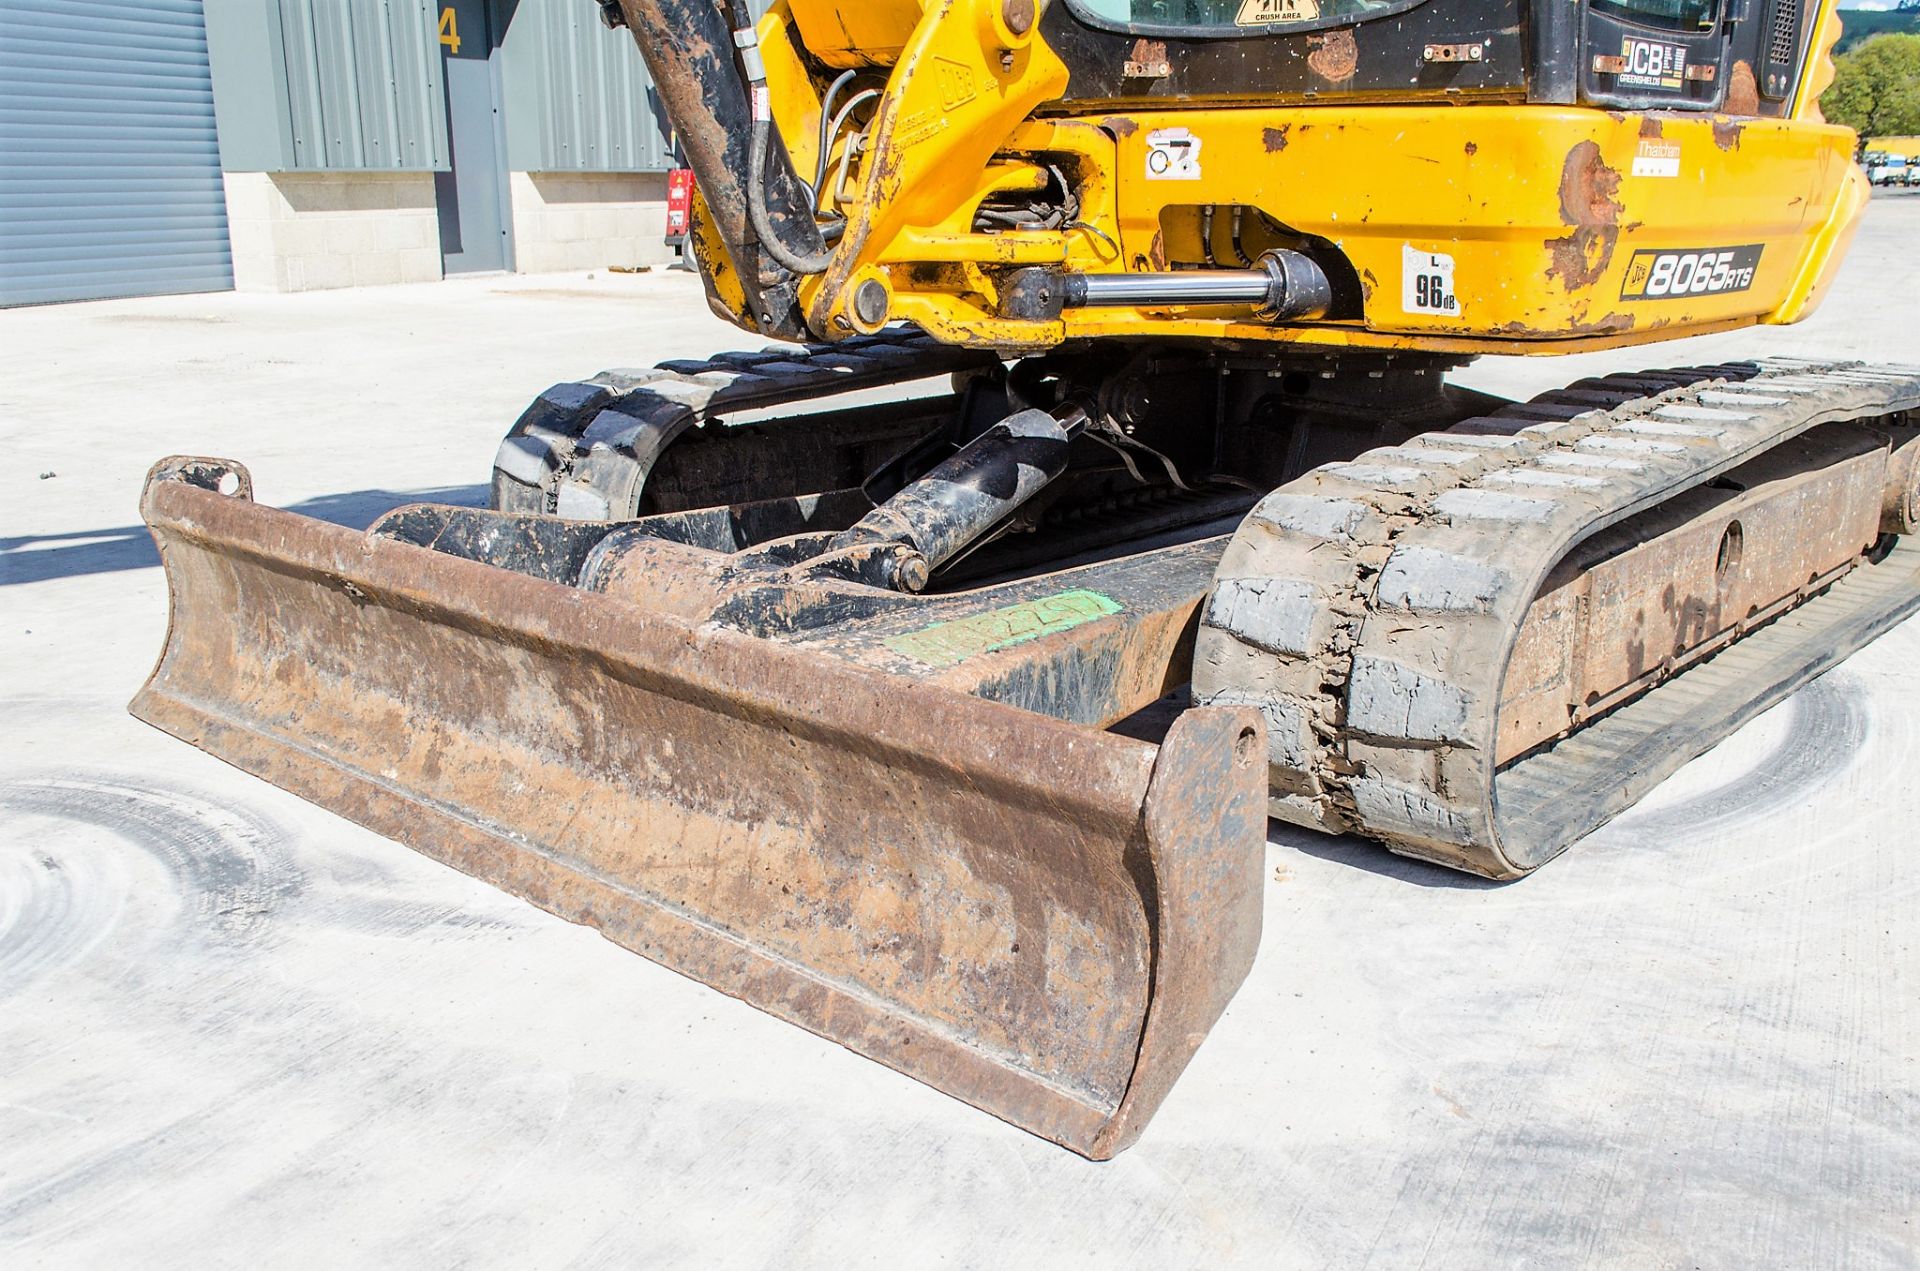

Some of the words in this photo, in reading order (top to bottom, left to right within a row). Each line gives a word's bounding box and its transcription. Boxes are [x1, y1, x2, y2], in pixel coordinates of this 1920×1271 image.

[438, 7, 460, 54] 4
[1623, 41, 1664, 76] JCB
[1431, 256, 1439, 267] L
[1416, 274, 1443, 309] 96
